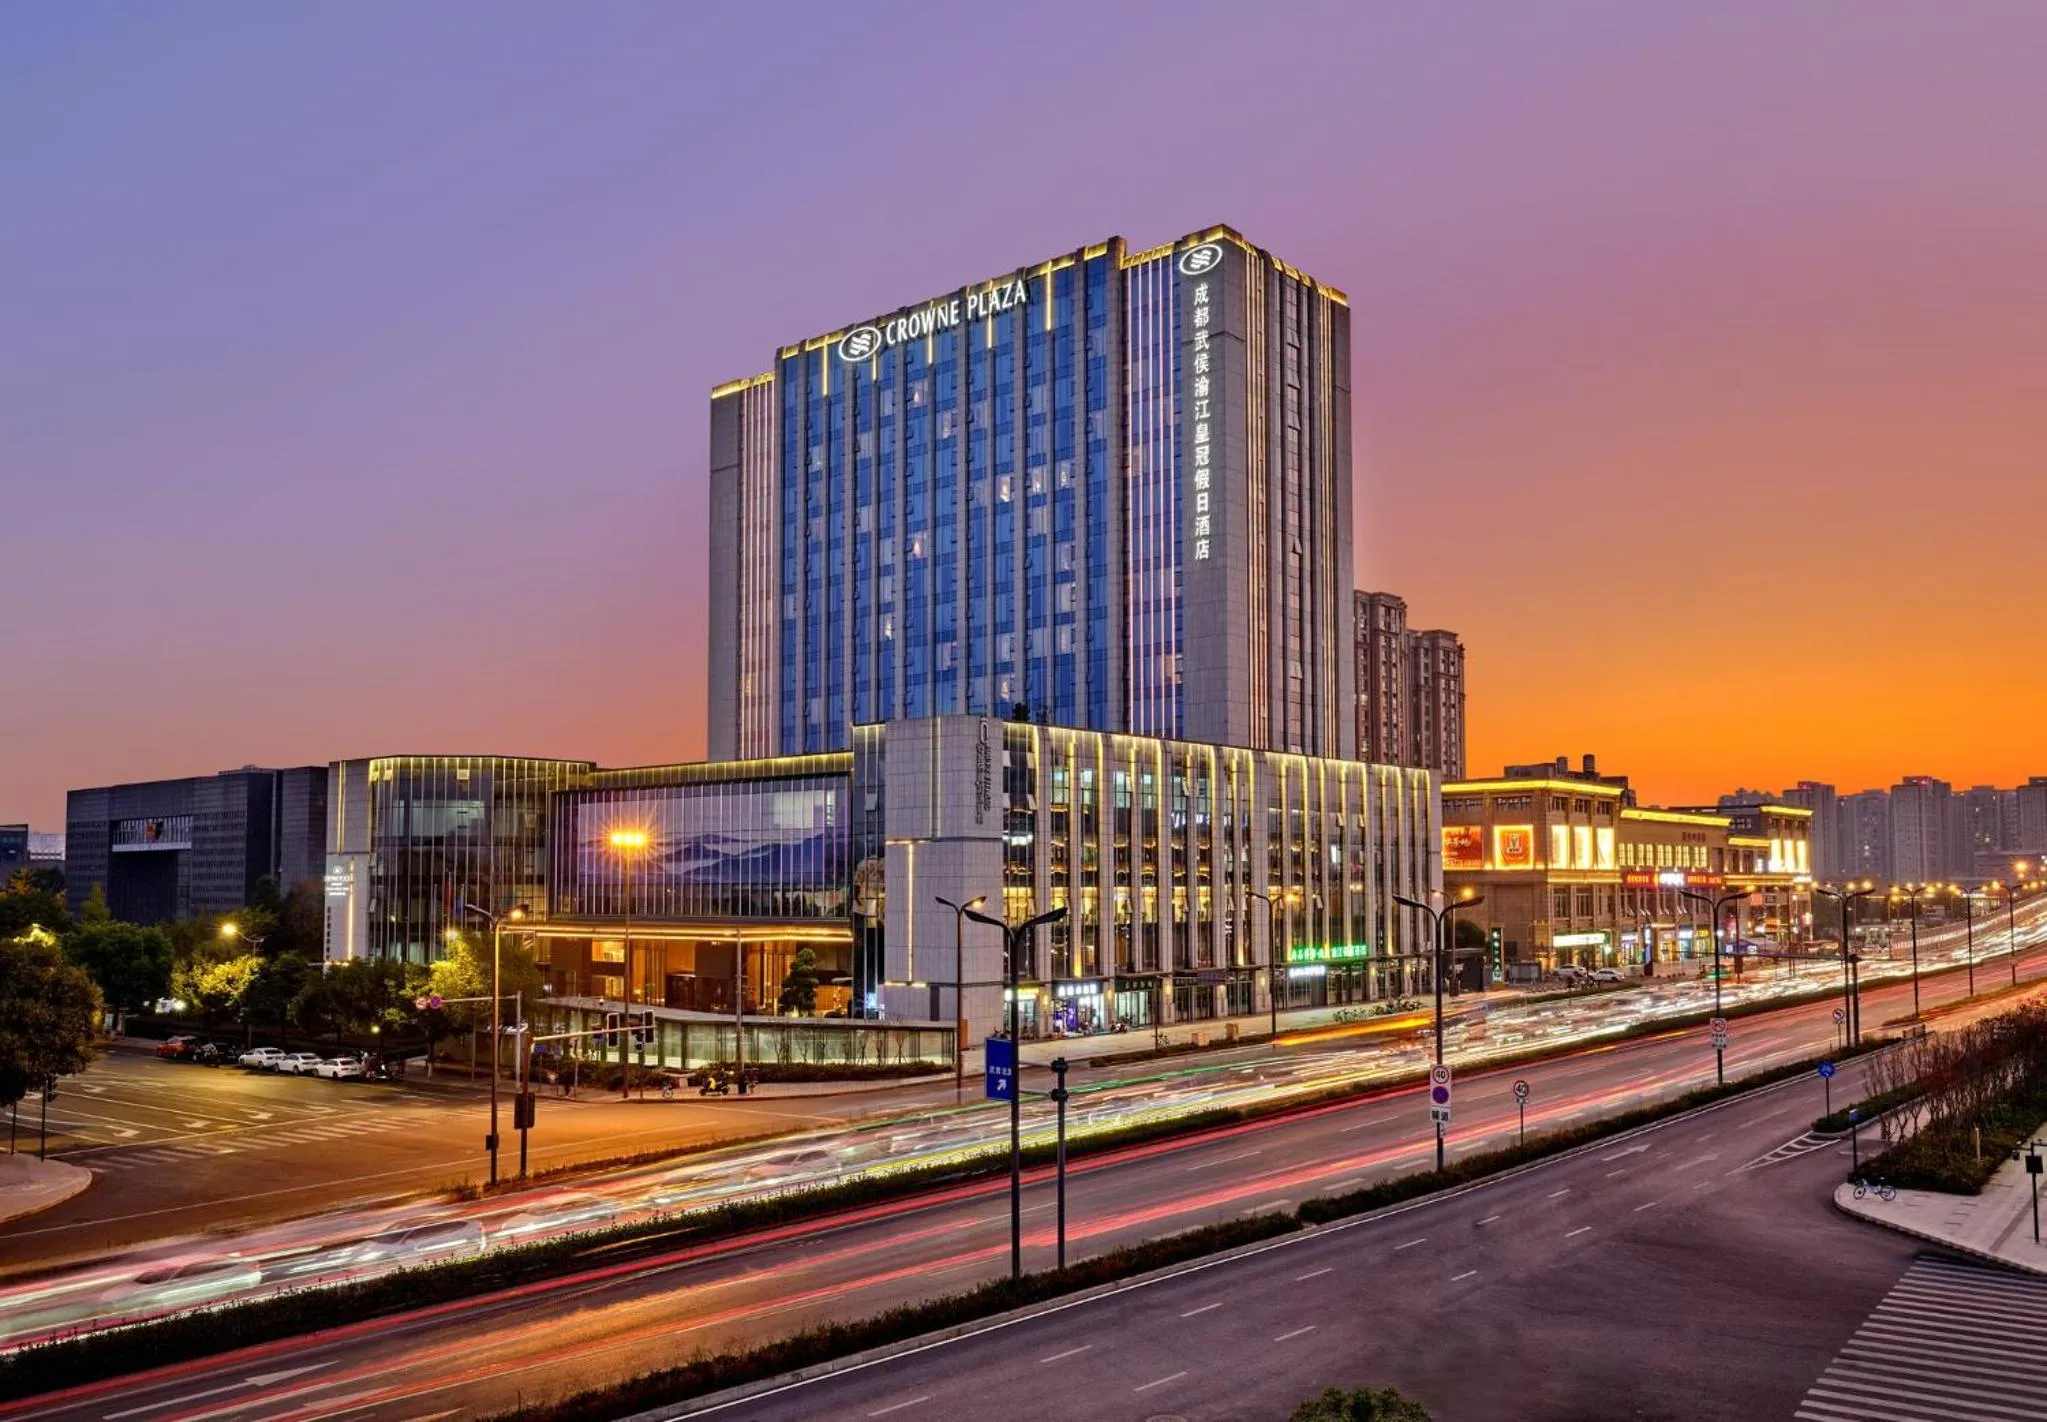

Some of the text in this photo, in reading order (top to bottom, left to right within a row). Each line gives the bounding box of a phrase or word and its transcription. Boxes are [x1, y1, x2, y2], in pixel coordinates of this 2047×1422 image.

[886, 279, 1027, 345] CROWNE PLAZA
[1193, 282, 1211, 560] 成都武侯渝江皇冠假日酒店
[1435, 1070, 1446, 1079] 40
[1515, 1083, 1526, 1093] 40
